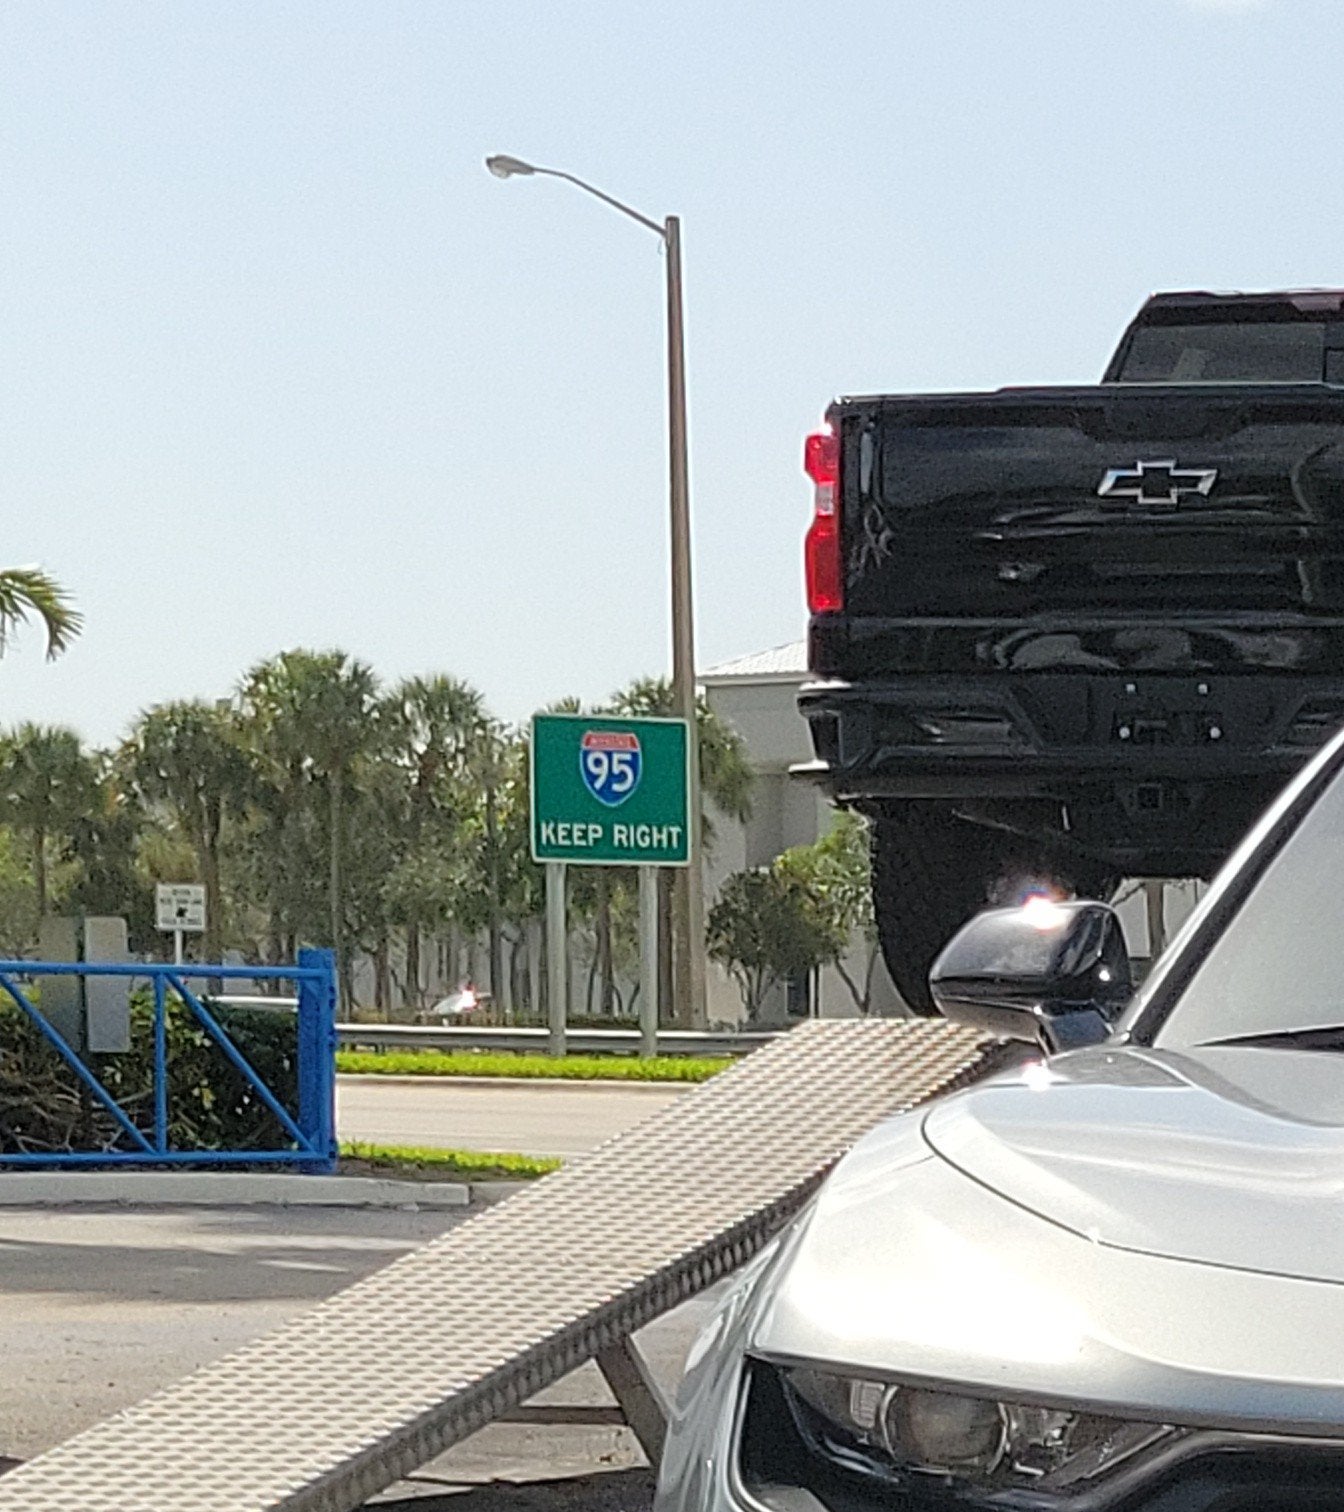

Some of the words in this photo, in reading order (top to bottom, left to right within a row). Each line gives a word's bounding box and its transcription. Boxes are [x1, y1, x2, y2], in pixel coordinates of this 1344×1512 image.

[586, 751, 634, 792] 95
[540, 821, 603, 847] KEEP
[613, 823, 682, 849] RIGHT
